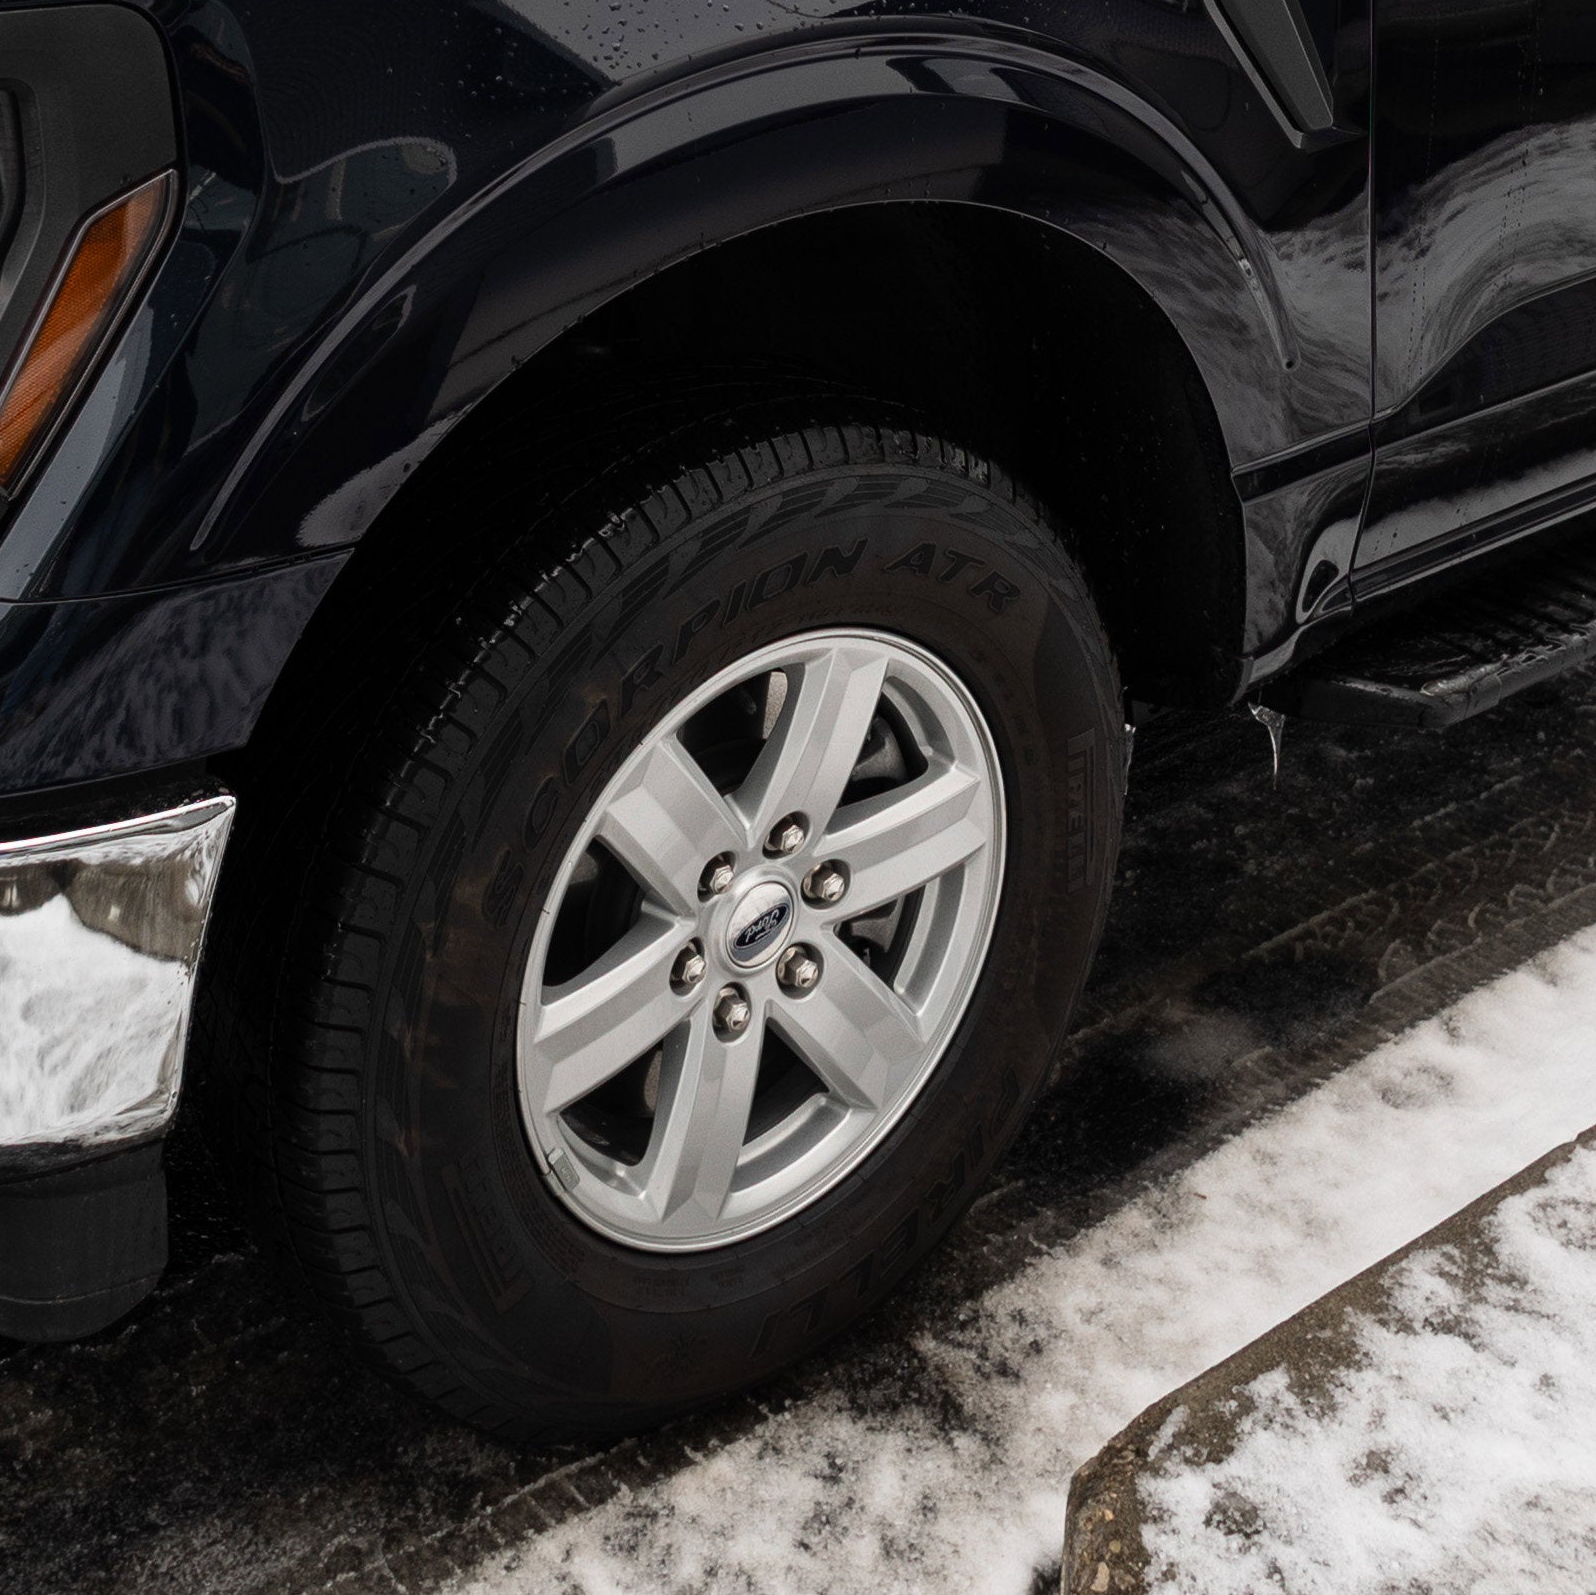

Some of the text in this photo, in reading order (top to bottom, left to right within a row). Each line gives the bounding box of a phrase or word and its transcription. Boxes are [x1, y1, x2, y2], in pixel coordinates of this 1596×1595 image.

[485, 537, 1020, 929] SCORPION ATR
[745, 908, 781, 943] Ford
